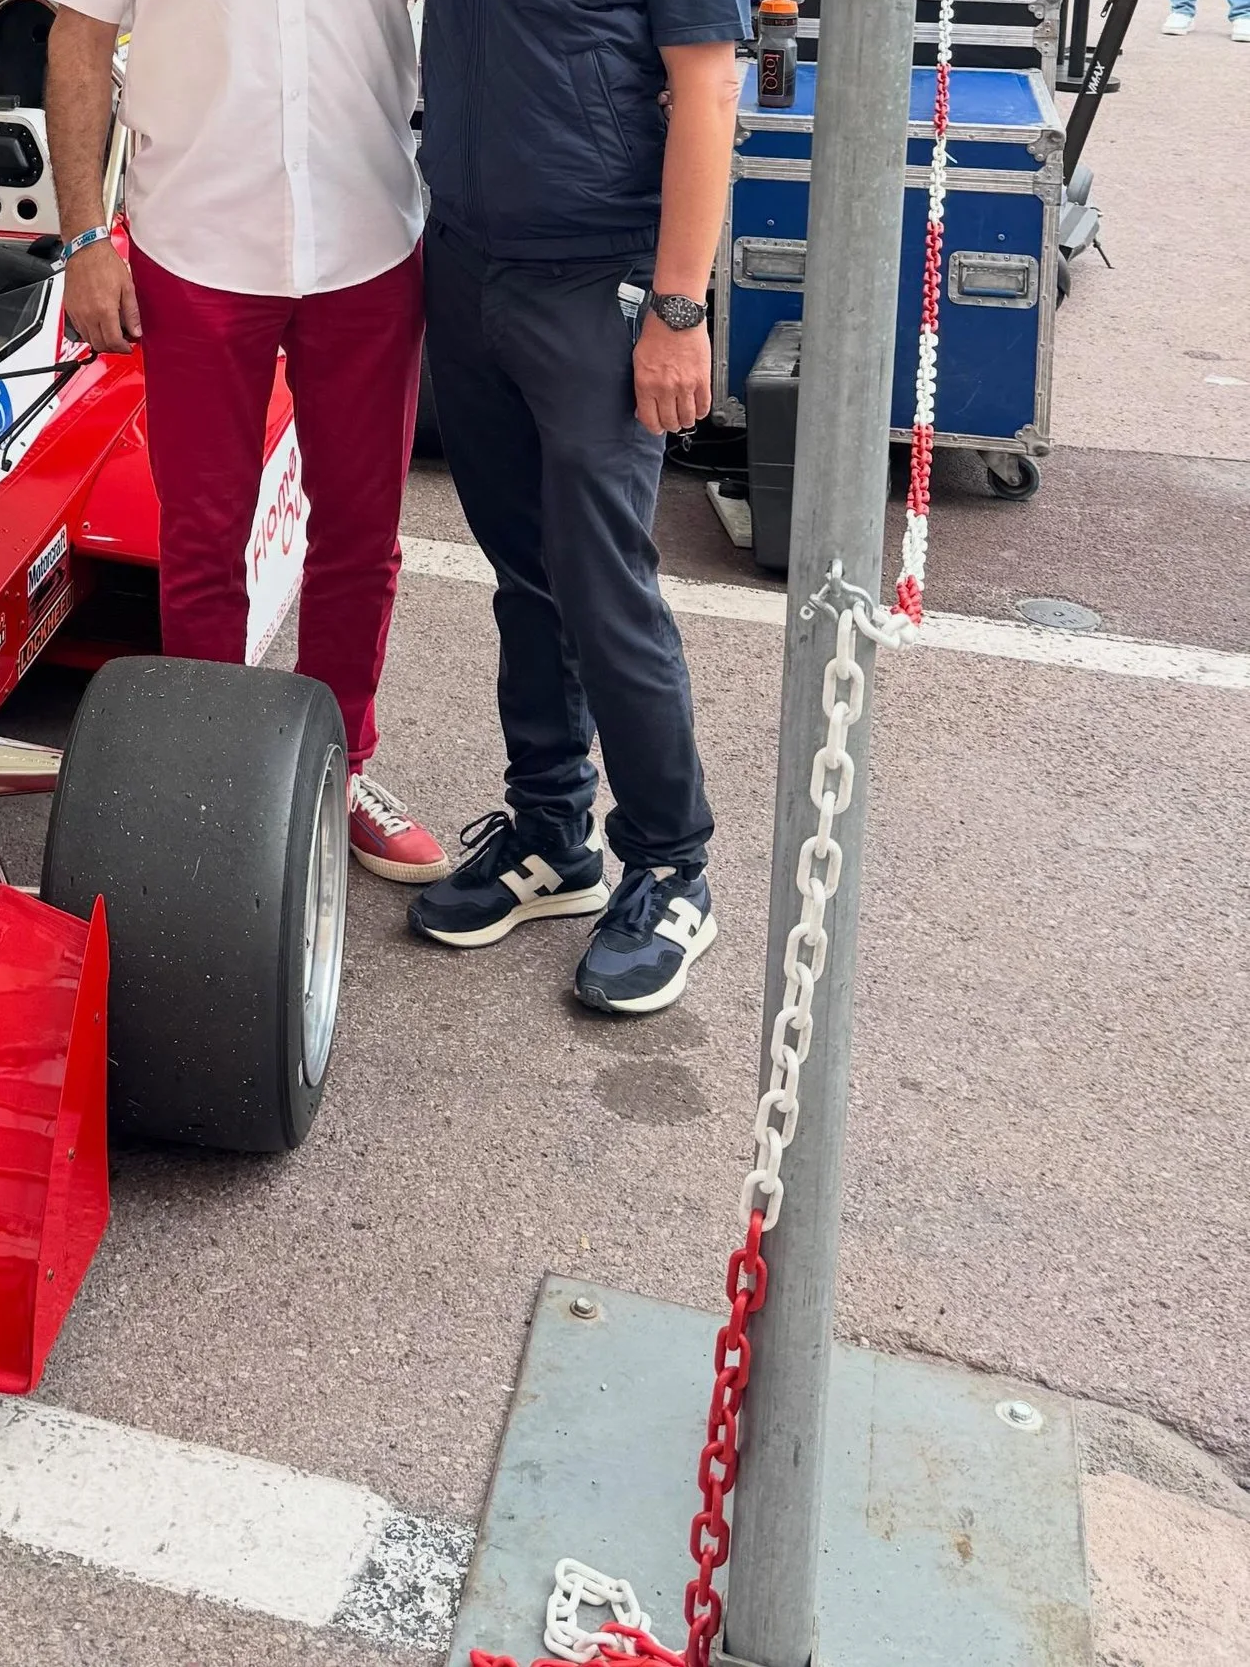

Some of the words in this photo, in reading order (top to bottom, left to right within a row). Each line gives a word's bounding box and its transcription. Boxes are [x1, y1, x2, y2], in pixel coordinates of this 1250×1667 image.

[1085, 60, 1106, 95] VMAX
[28, 528, 67, 594] Motorcraft
[20, 590, 73, 669] LOCKHEED
